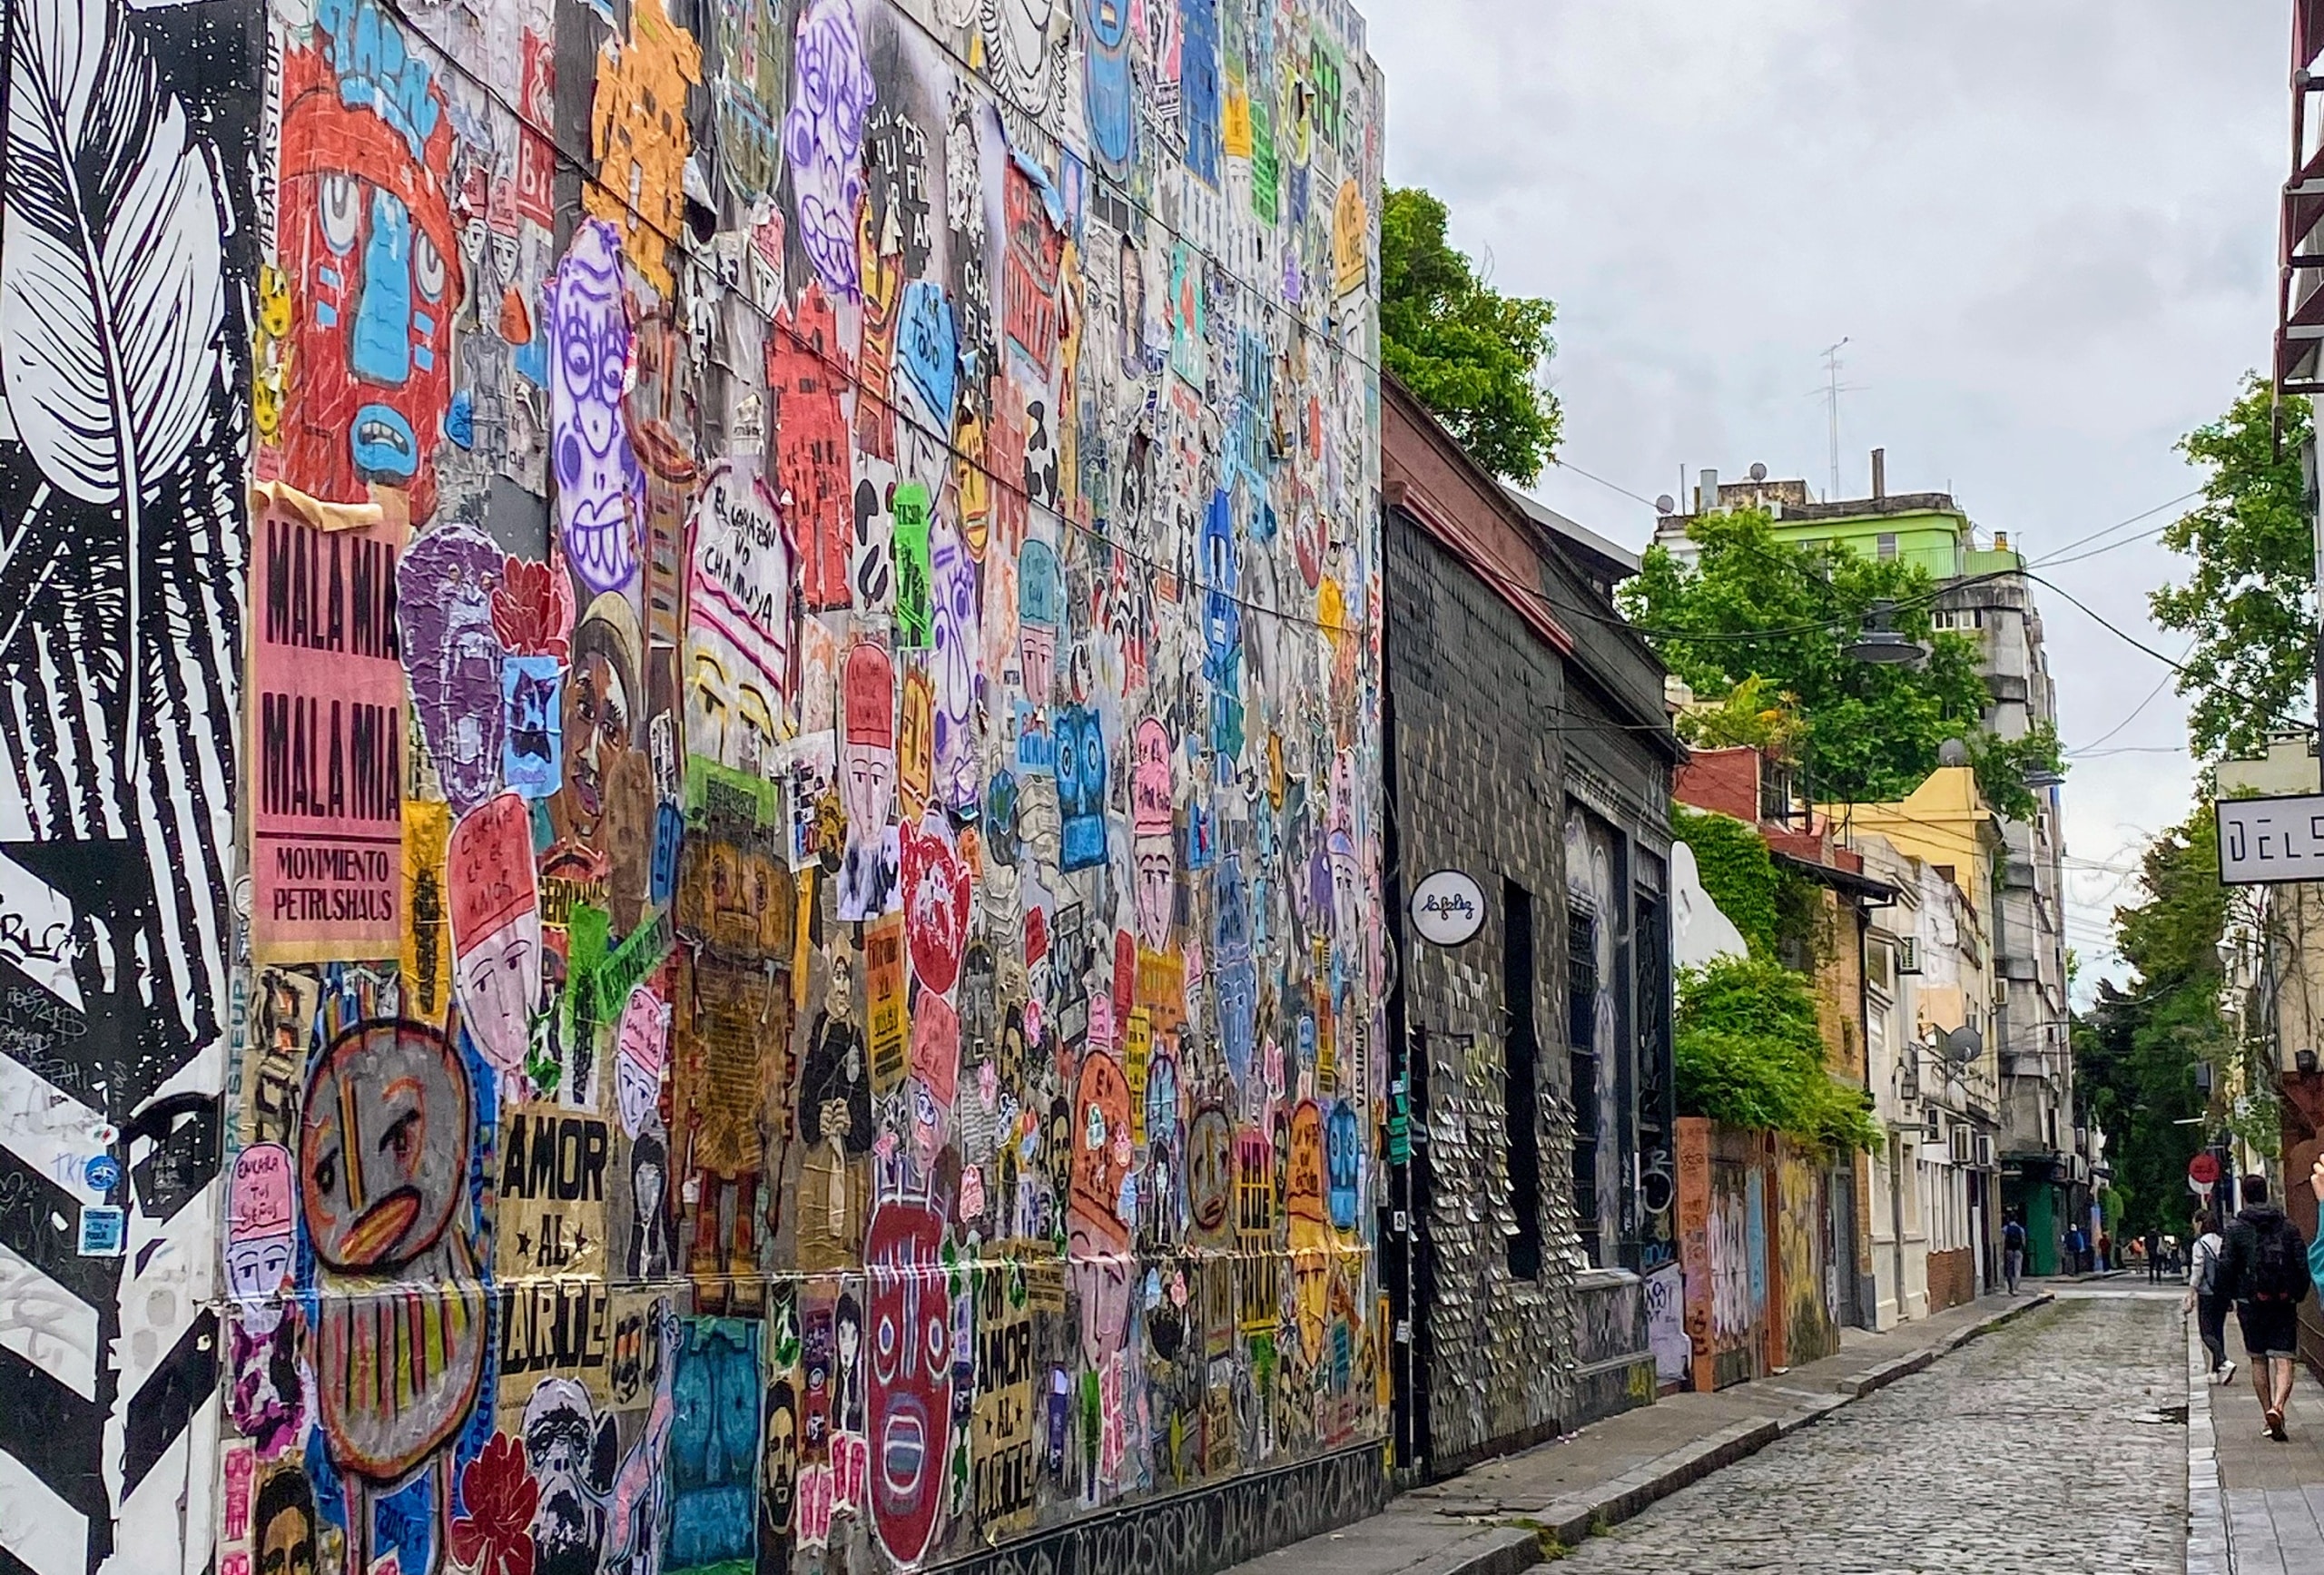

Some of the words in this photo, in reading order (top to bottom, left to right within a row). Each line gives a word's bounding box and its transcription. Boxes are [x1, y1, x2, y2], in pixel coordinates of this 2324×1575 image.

[266, 520, 344, 652] MALA
[352, 536, 399, 661] MIA
[704, 546, 773, 634] CHAMUYA
[262, 692, 344, 818] MALA
[351, 702, 400, 822] MIA
[273, 888, 392, 921] PETRUSHAUS
[276, 847, 389, 883] MOVIMIENTO
[500, 1114, 607, 1201] AMOR
[537, 1214, 569, 1266] AL
[500, 1280, 607, 1374] ARTE
[981, 1267, 1004, 1321] OR
[977, 1321, 1030, 1394] AMOR
[998, 1400, 1013, 1441] AL
[974, 1441, 1033, 1526] ARTE
